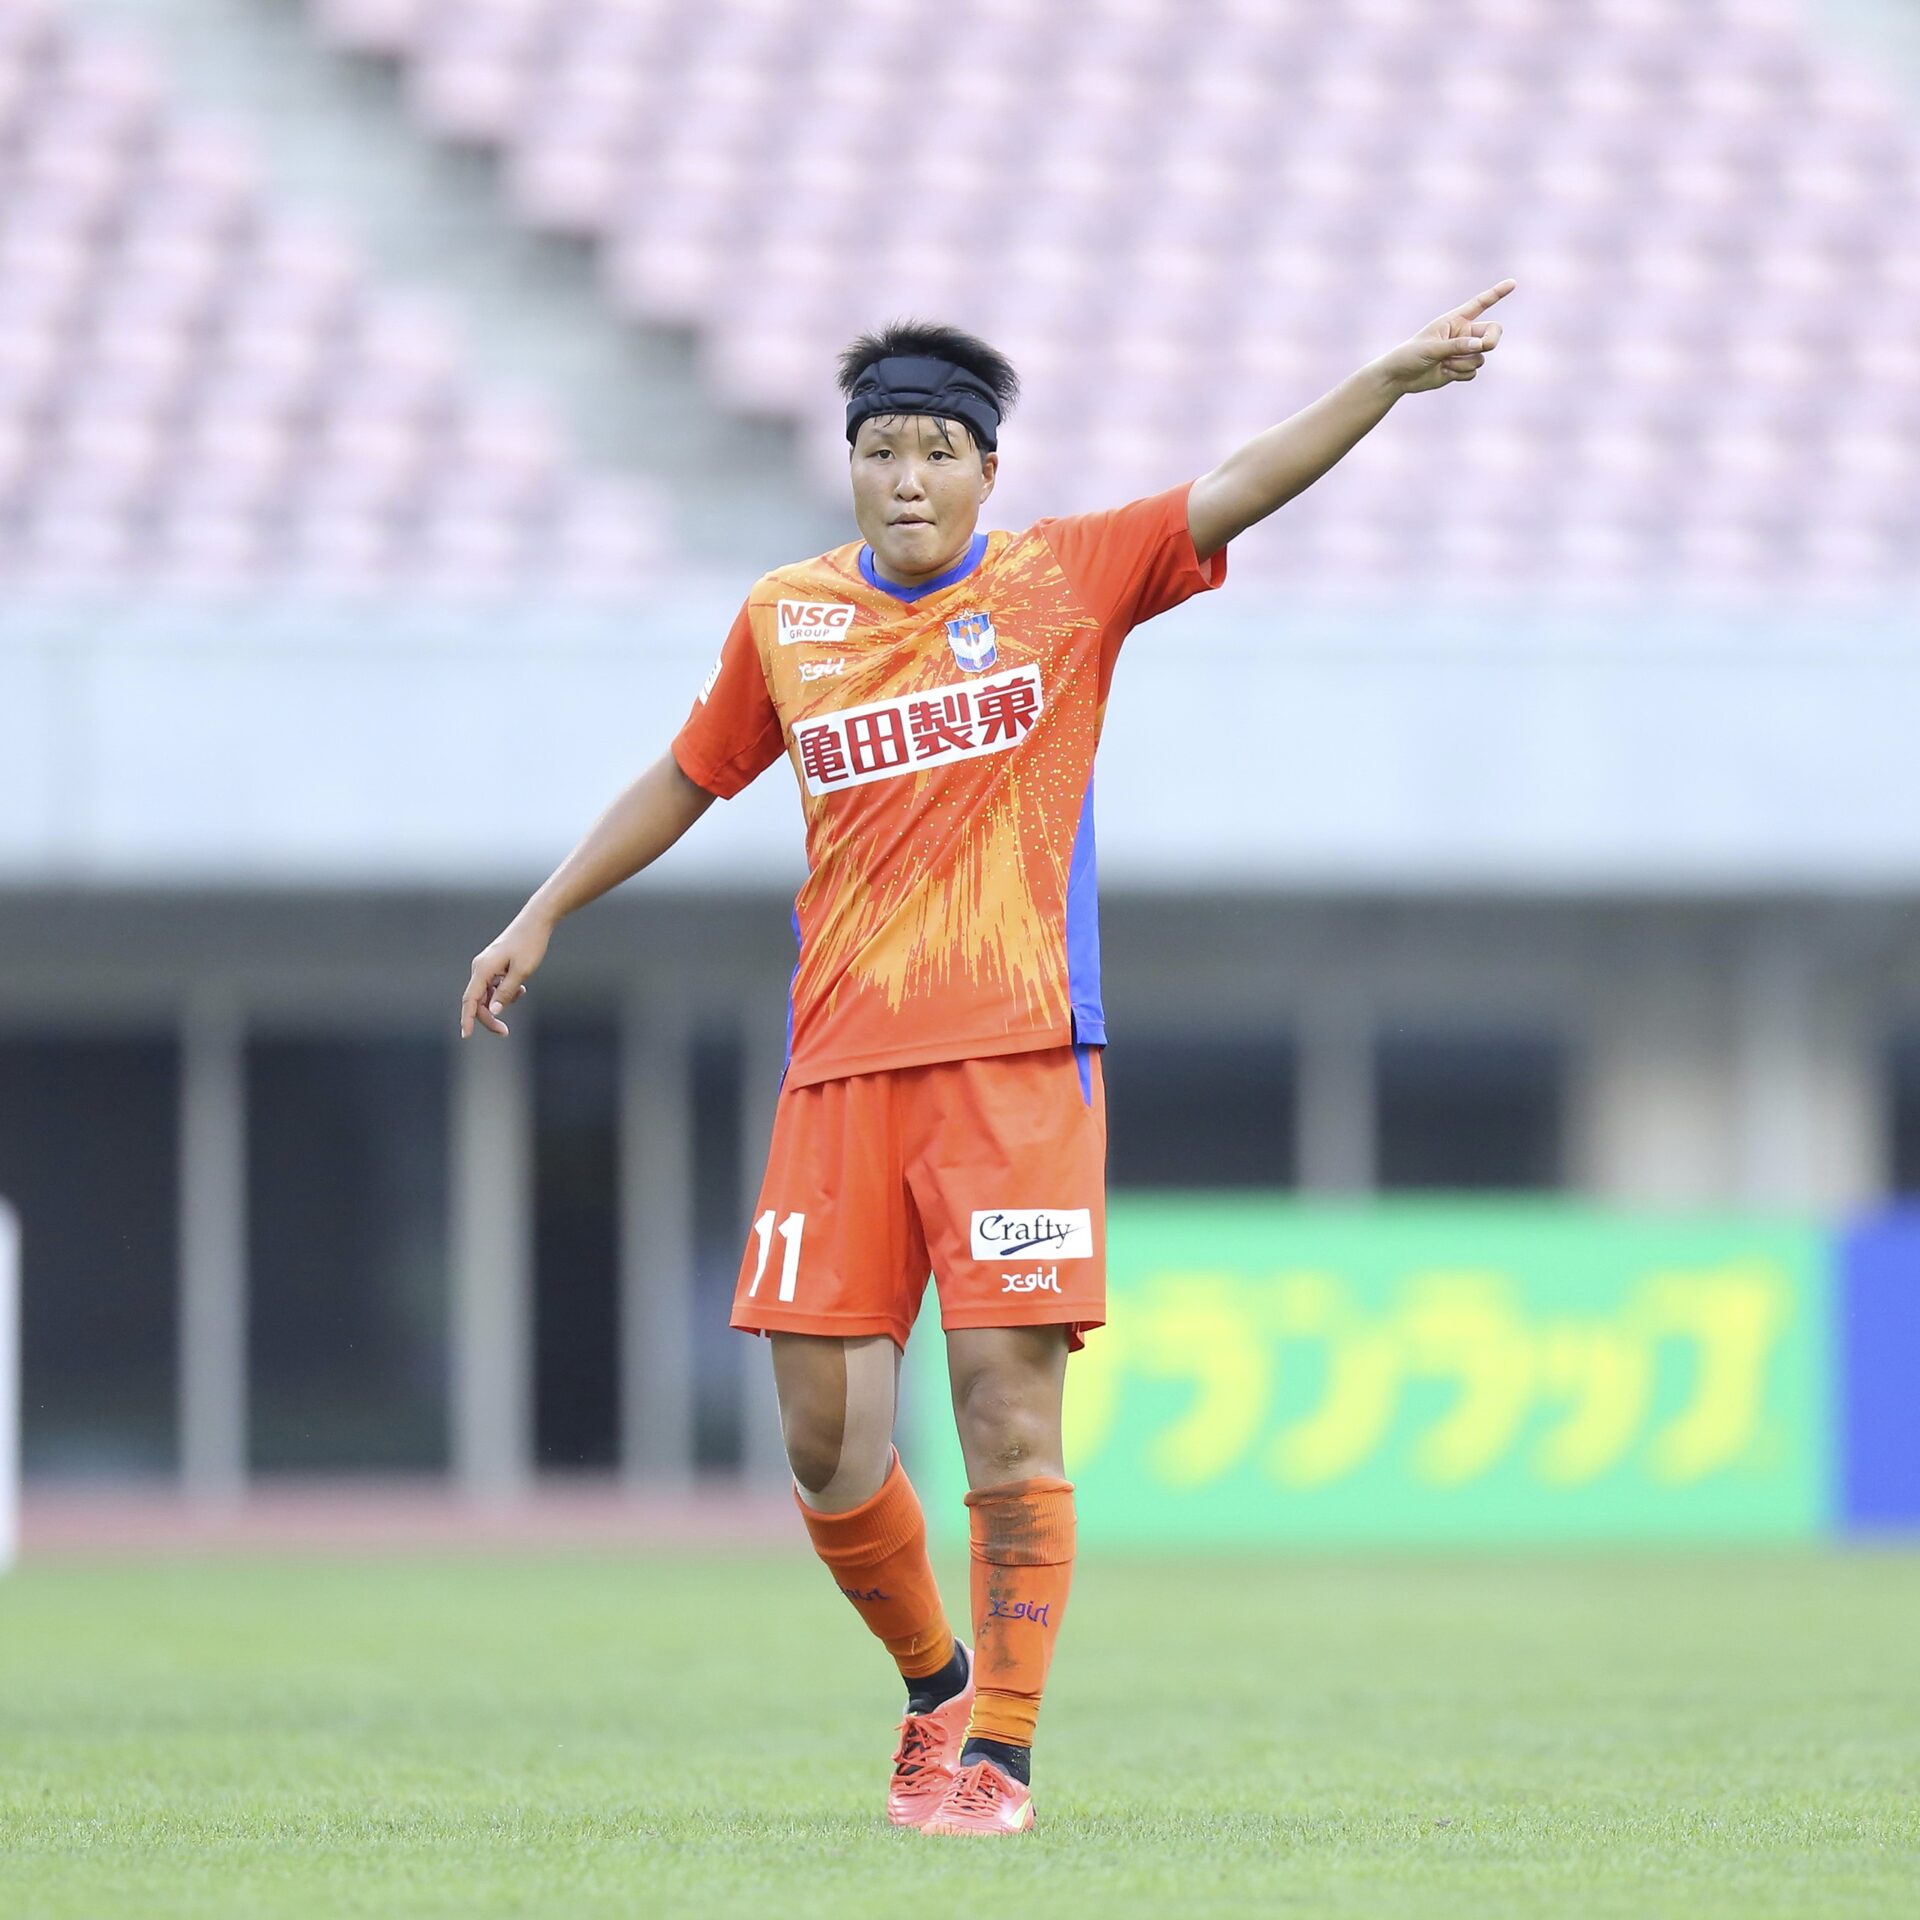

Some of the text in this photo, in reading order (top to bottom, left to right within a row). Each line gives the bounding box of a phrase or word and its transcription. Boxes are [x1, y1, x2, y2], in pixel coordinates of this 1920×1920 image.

[781, 604, 849, 628] NSG
[789, 629, 830, 639] GROUP
[799, 676, 1039, 784] 亀田製菓
[979, 1214, 1072, 1249] Crafty
[748, 1209, 806, 1303] 11
